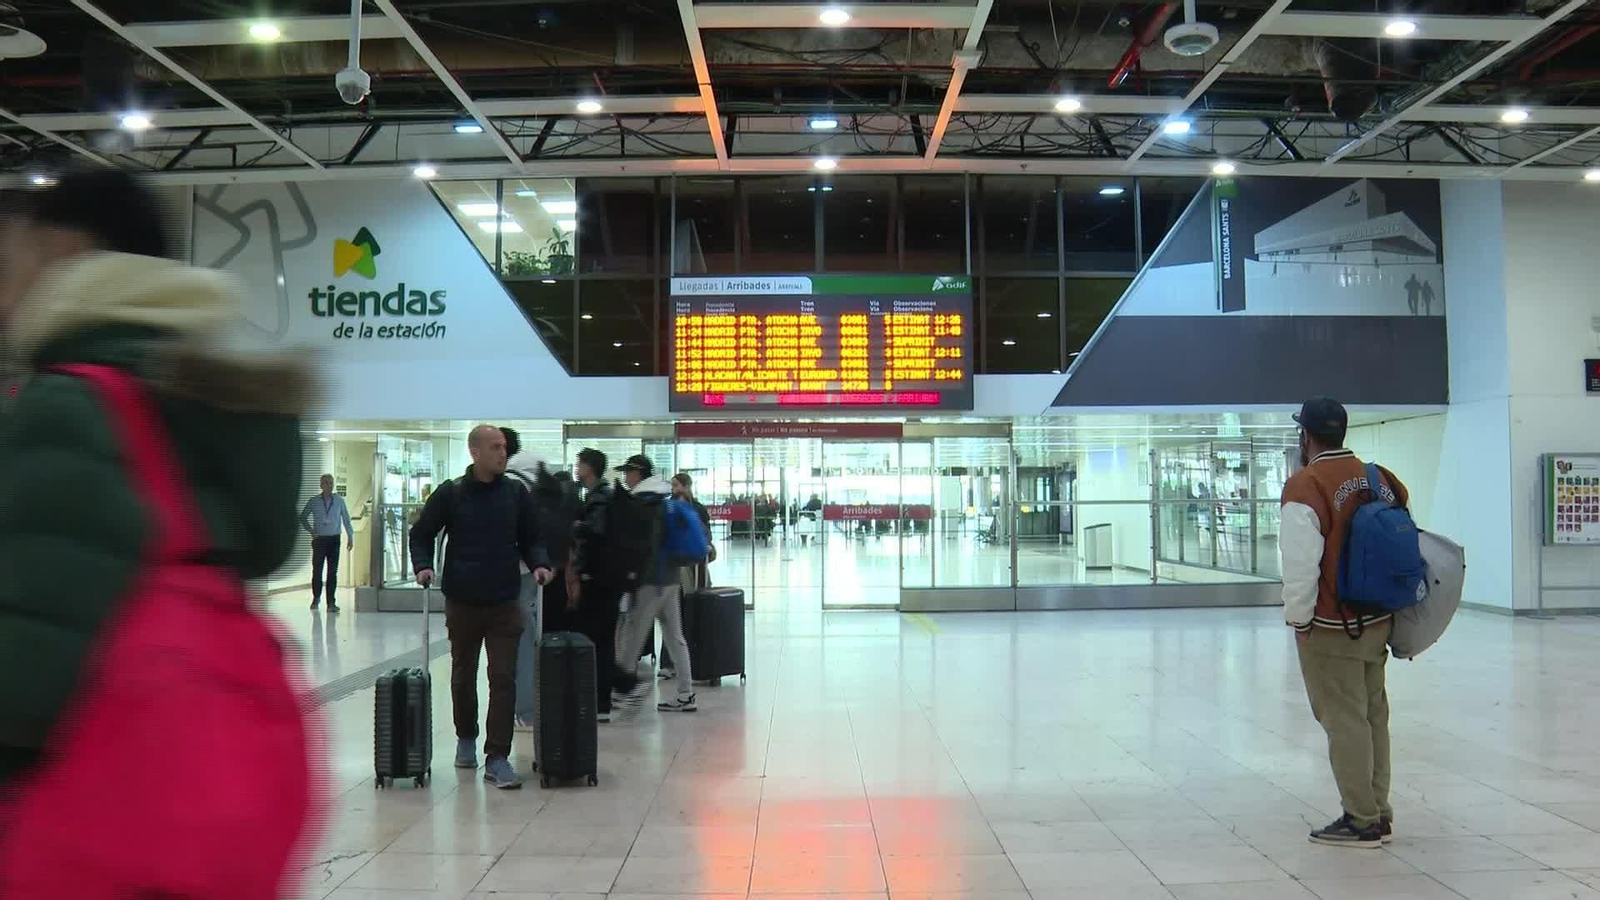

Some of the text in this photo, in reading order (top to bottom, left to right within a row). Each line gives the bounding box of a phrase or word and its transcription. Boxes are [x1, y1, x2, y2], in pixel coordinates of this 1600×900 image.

[1223, 237, 1231, 279] BARCELONA
[680, 280, 718, 292] Llegadas
[727, 280, 771, 291] Arribades
[308, 283, 447, 317] tiendas
[704, 316, 736, 326] MADRID
[740, 316, 761, 326] PTA.
[766, 315, 798, 326] ATOCHA
[884, 315, 892, 325] 5
[893, 315, 930, 325] ESTIMAT
[333, 321, 446, 339] de la estación
[676, 327, 702, 337] 11:24
[704, 327, 736, 337] MADRID
[740, 327, 761, 337] PTA.
[766, 326, 798, 336] ATOCHA
[884, 326, 892, 336] 1
[893, 326, 930, 336] ESTIMAT
[676, 338, 702, 348] 11:44
[704, 337, 736, 347] MADRID
[740, 337, 761, 347] PTA.
[766, 337, 798, 347] ATOCHA
[893, 336, 936, 346] SUPRIMIT
[676, 349, 702, 359] 11:52
[704, 349, 736, 359] MADRID
[740, 348, 761, 358] PTA.
[766, 348, 798, 358] ATOCHA
[884, 348, 892, 358] 3
[893, 348, 930, 358] ESTIMAT
[934, 347, 962, 357] 12:11
[704, 360, 736, 370] MADRID
[740, 360, 761, 370] PTA.
[766, 359, 798, 369] ATOCHA
[893, 359, 936, 369] SUPRIMIT
[884, 370, 892, 380] 5
[893, 369, 930, 379] ESTIMAT
[934, 369, 962, 379] 12:44
[842, 507, 882, 515] Arribades
